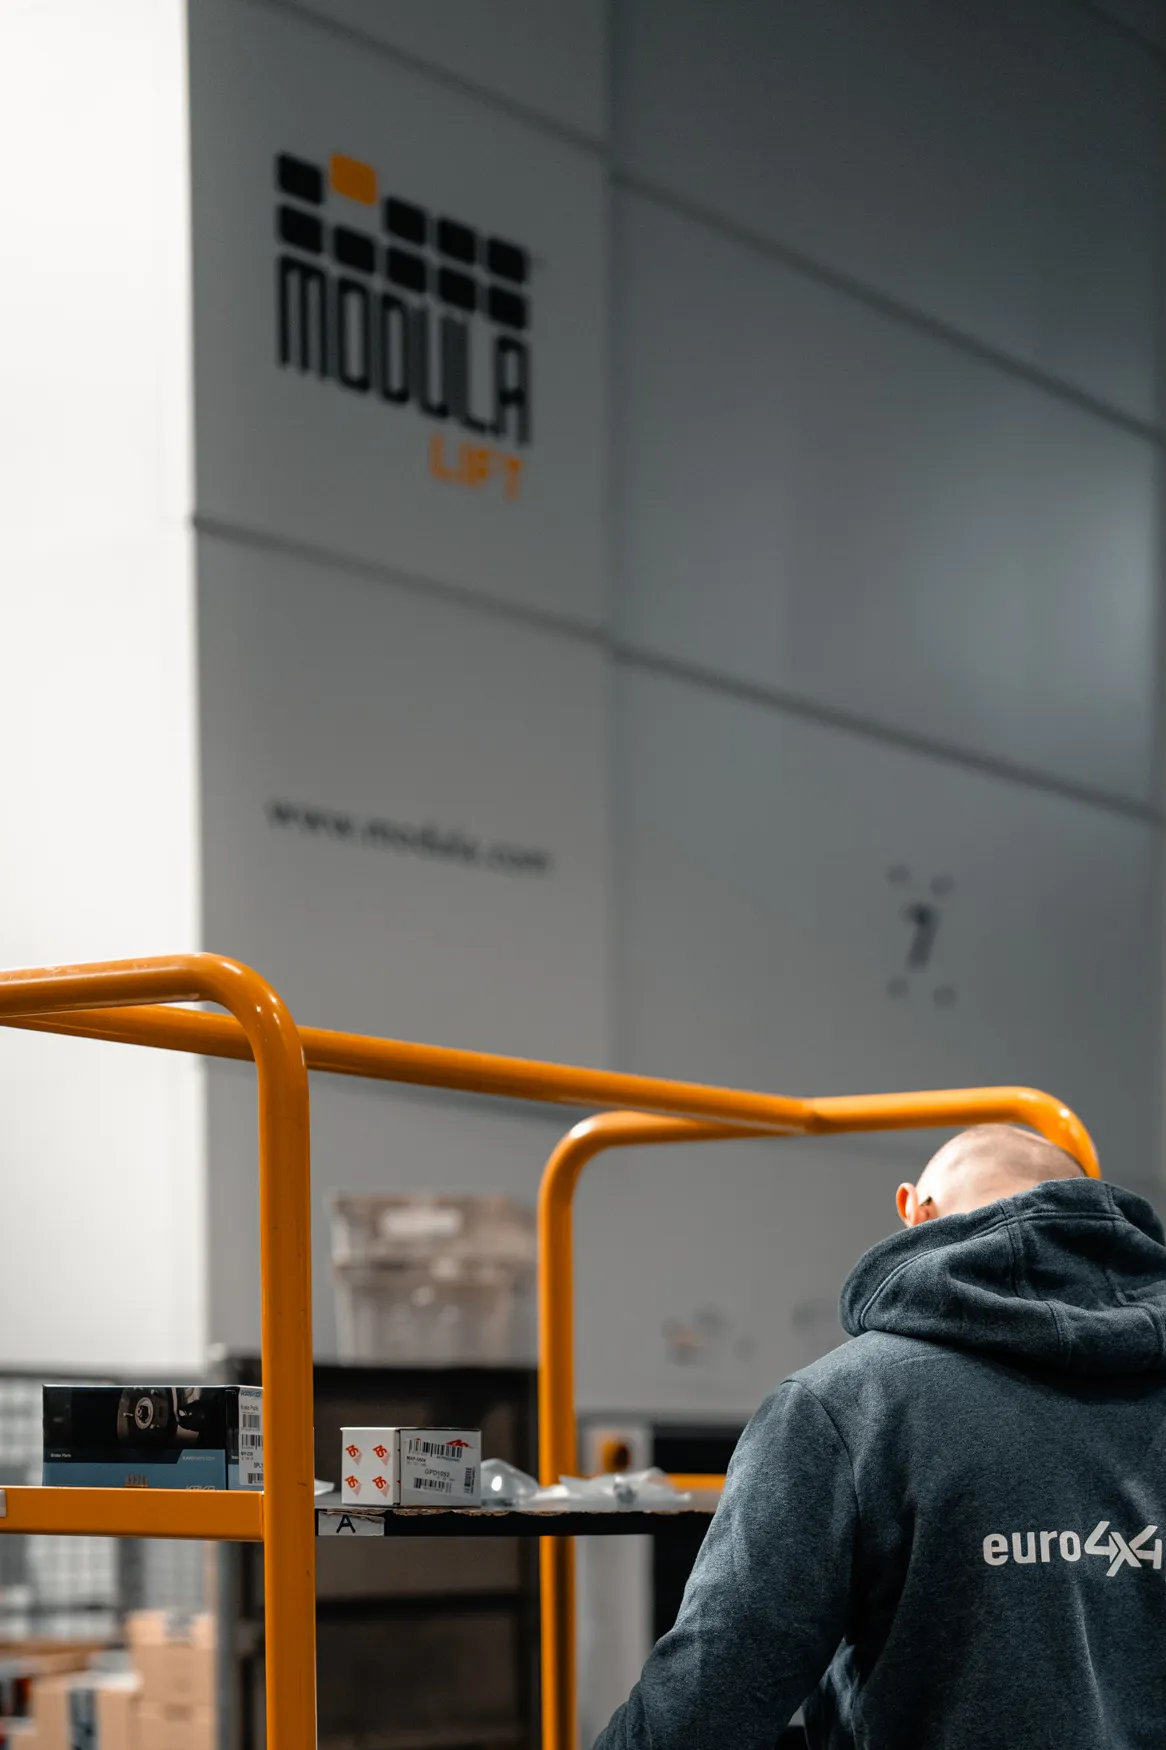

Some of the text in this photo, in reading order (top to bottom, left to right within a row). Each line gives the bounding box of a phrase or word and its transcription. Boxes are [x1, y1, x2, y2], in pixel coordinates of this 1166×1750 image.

[275, 255, 532, 448] MODULA
[428, 433, 525, 503] LIFT
[336, 1514, 356, 1534] A
